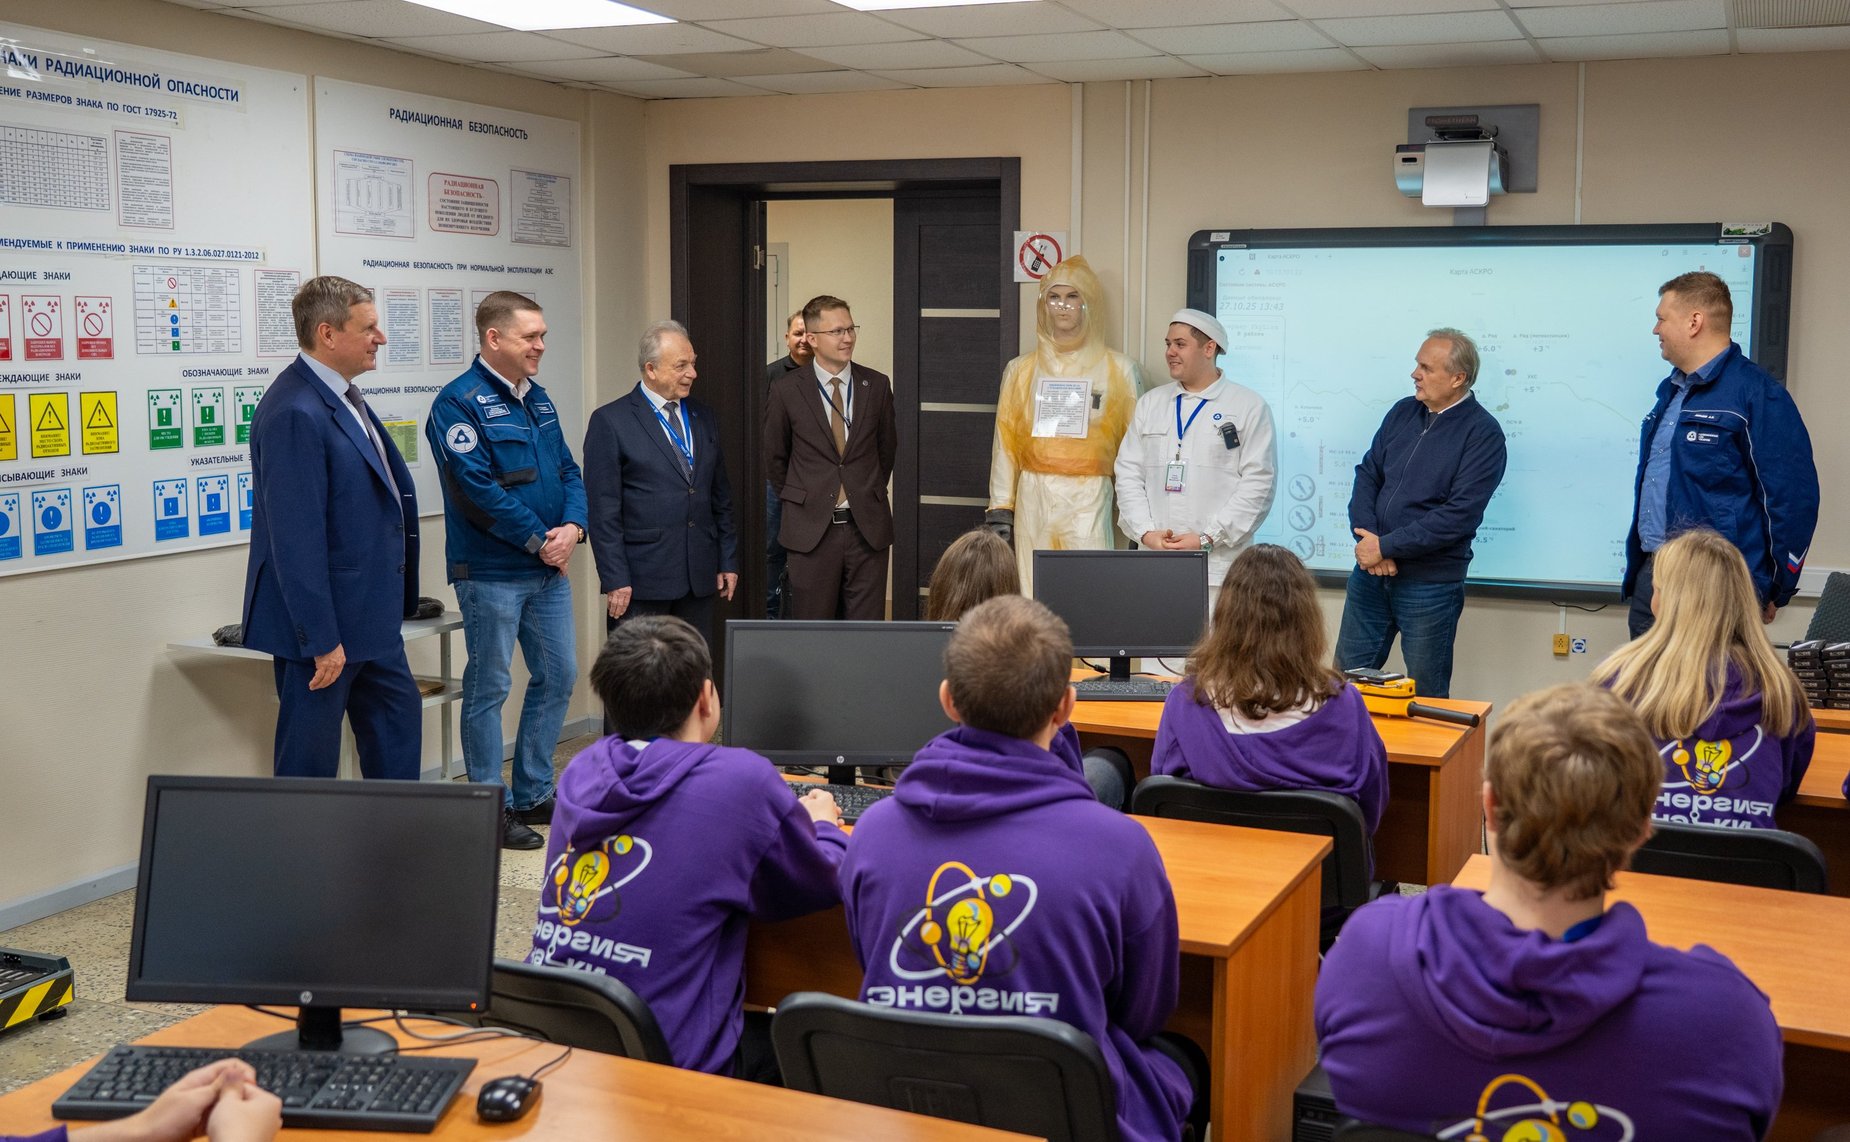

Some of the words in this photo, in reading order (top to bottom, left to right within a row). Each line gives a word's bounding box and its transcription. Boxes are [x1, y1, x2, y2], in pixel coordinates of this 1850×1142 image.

[46, 58, 161, 90] РАДИАЦИОННОЙ
[167, 79, 239, 102] ОПАСНОСТИ
[26, 90, 72, 105] РАЗМЕРОВ
[76, 97, 103, 110] ЗНАКА
[107, 102, 119, 111] ПО
[122, 103, 142, 116] ГОСТ
[145, 107, 178, 120] 17925-72
[389, 108, 463, 130] РАДИАЦИОННАЯ
[469, 121, 528, 140] БЕЗОПАСНОСТЬ
[57, 241, 63, 249] К
[66, 241, 126, 253] ПРИМЕНЕНИЮ
[129, 245, 155, 254] ЗНАКИ
[158, 246, 170, 255] ПО
[173, 247, 182, 256] РУ
[185, 248, 259, 260] 1.3.2.06.027.0121-2012
[363, 259, 410, 269] РАДИАЦИОННАЯ
[413, 261, 453, 271] БЕЗОПАСНОСТЬ
[457, 263, 466, 271] ПРИ
[470, 263, 505, 273] НОРМАЛЬНОЙ
[507, 265, 542, 275] ЭКСПЛУАТАЦИИ
[0, 270, 37, 281] АЮЩИЕ
[43, 271, 71, 281] ЗНАКИ
[1219, 302, 1257, 311] 27.10.25
[55, 372, 81, 382] ЗНАКИ
[182, 367, 243, 379] ОБОЗНАЧАЮЩИЕ
[247, 366, 269, 376] ЗНАКИ
[361, 387, 400, 396] ДИАЦИОННАЯ
[190, 454, 244, 466] УКАЗАТЕЛЬНЫЕ
[0, 469, 55, 483] СЫВАЮЩИЕ
[61, 467, 88, 477] ЗНАКИ
